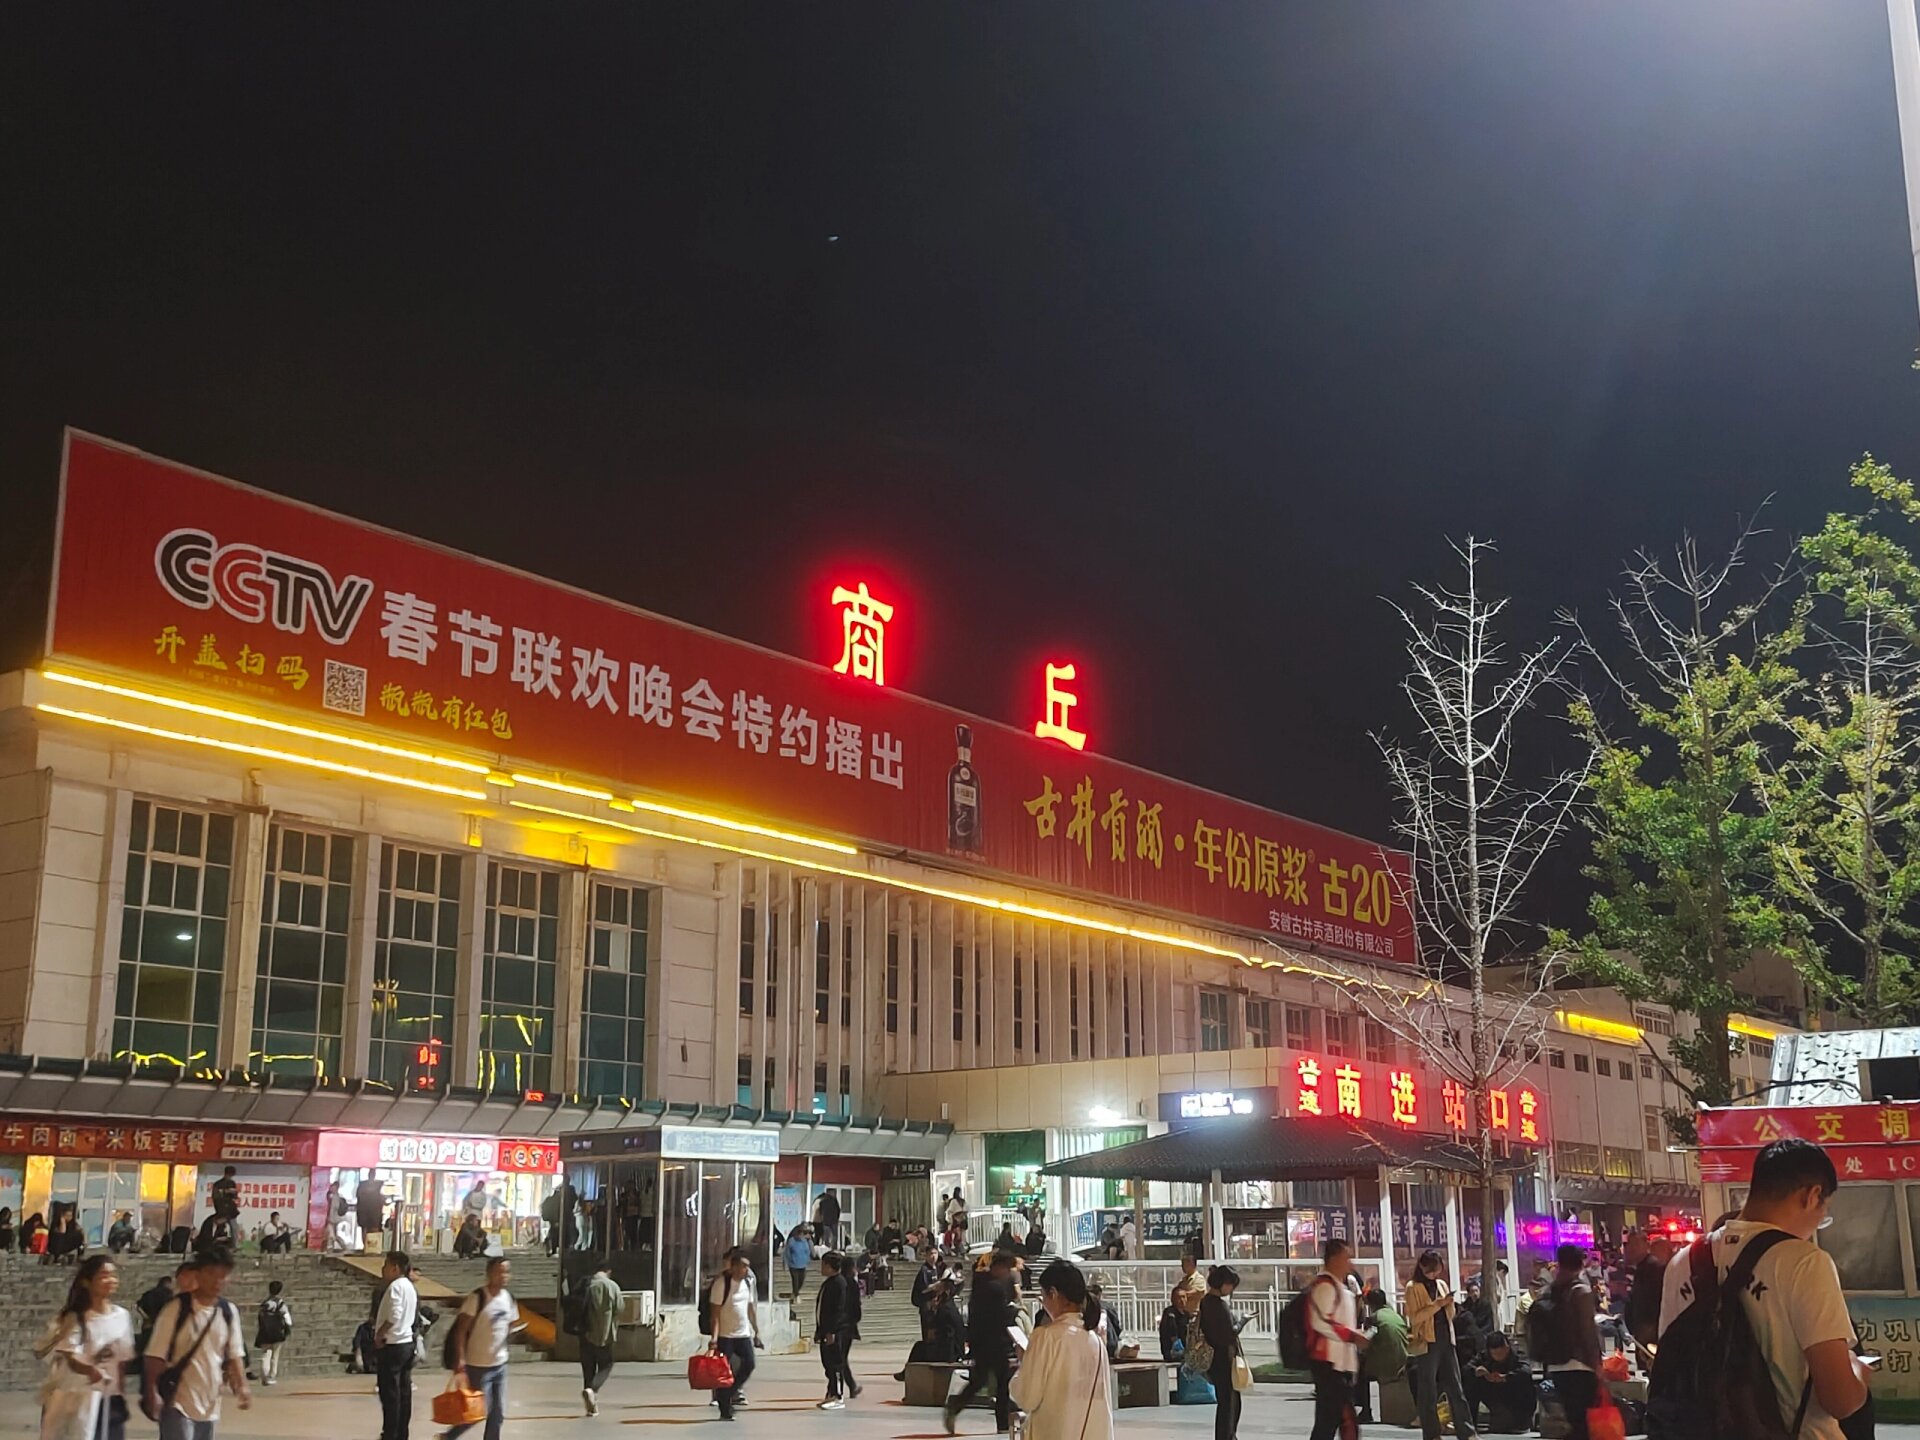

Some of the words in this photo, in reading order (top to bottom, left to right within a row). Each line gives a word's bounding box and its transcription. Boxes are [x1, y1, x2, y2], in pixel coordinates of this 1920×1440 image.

[154, 625, 310, 690] 开盖扫码
[156, 528, 373, 646] CCTV
[380, 590, 905, 790] 春节联欢晚会特约播出
[379, 681, 513, 740] 瓶瓶有红包
[1268, 908, 1395, 958] 安徽古井贡酒股份有限公司
[1335, 1063, 1510, 1131] 南进站口
[1752, 1108, 1910, 1140] 公交调
